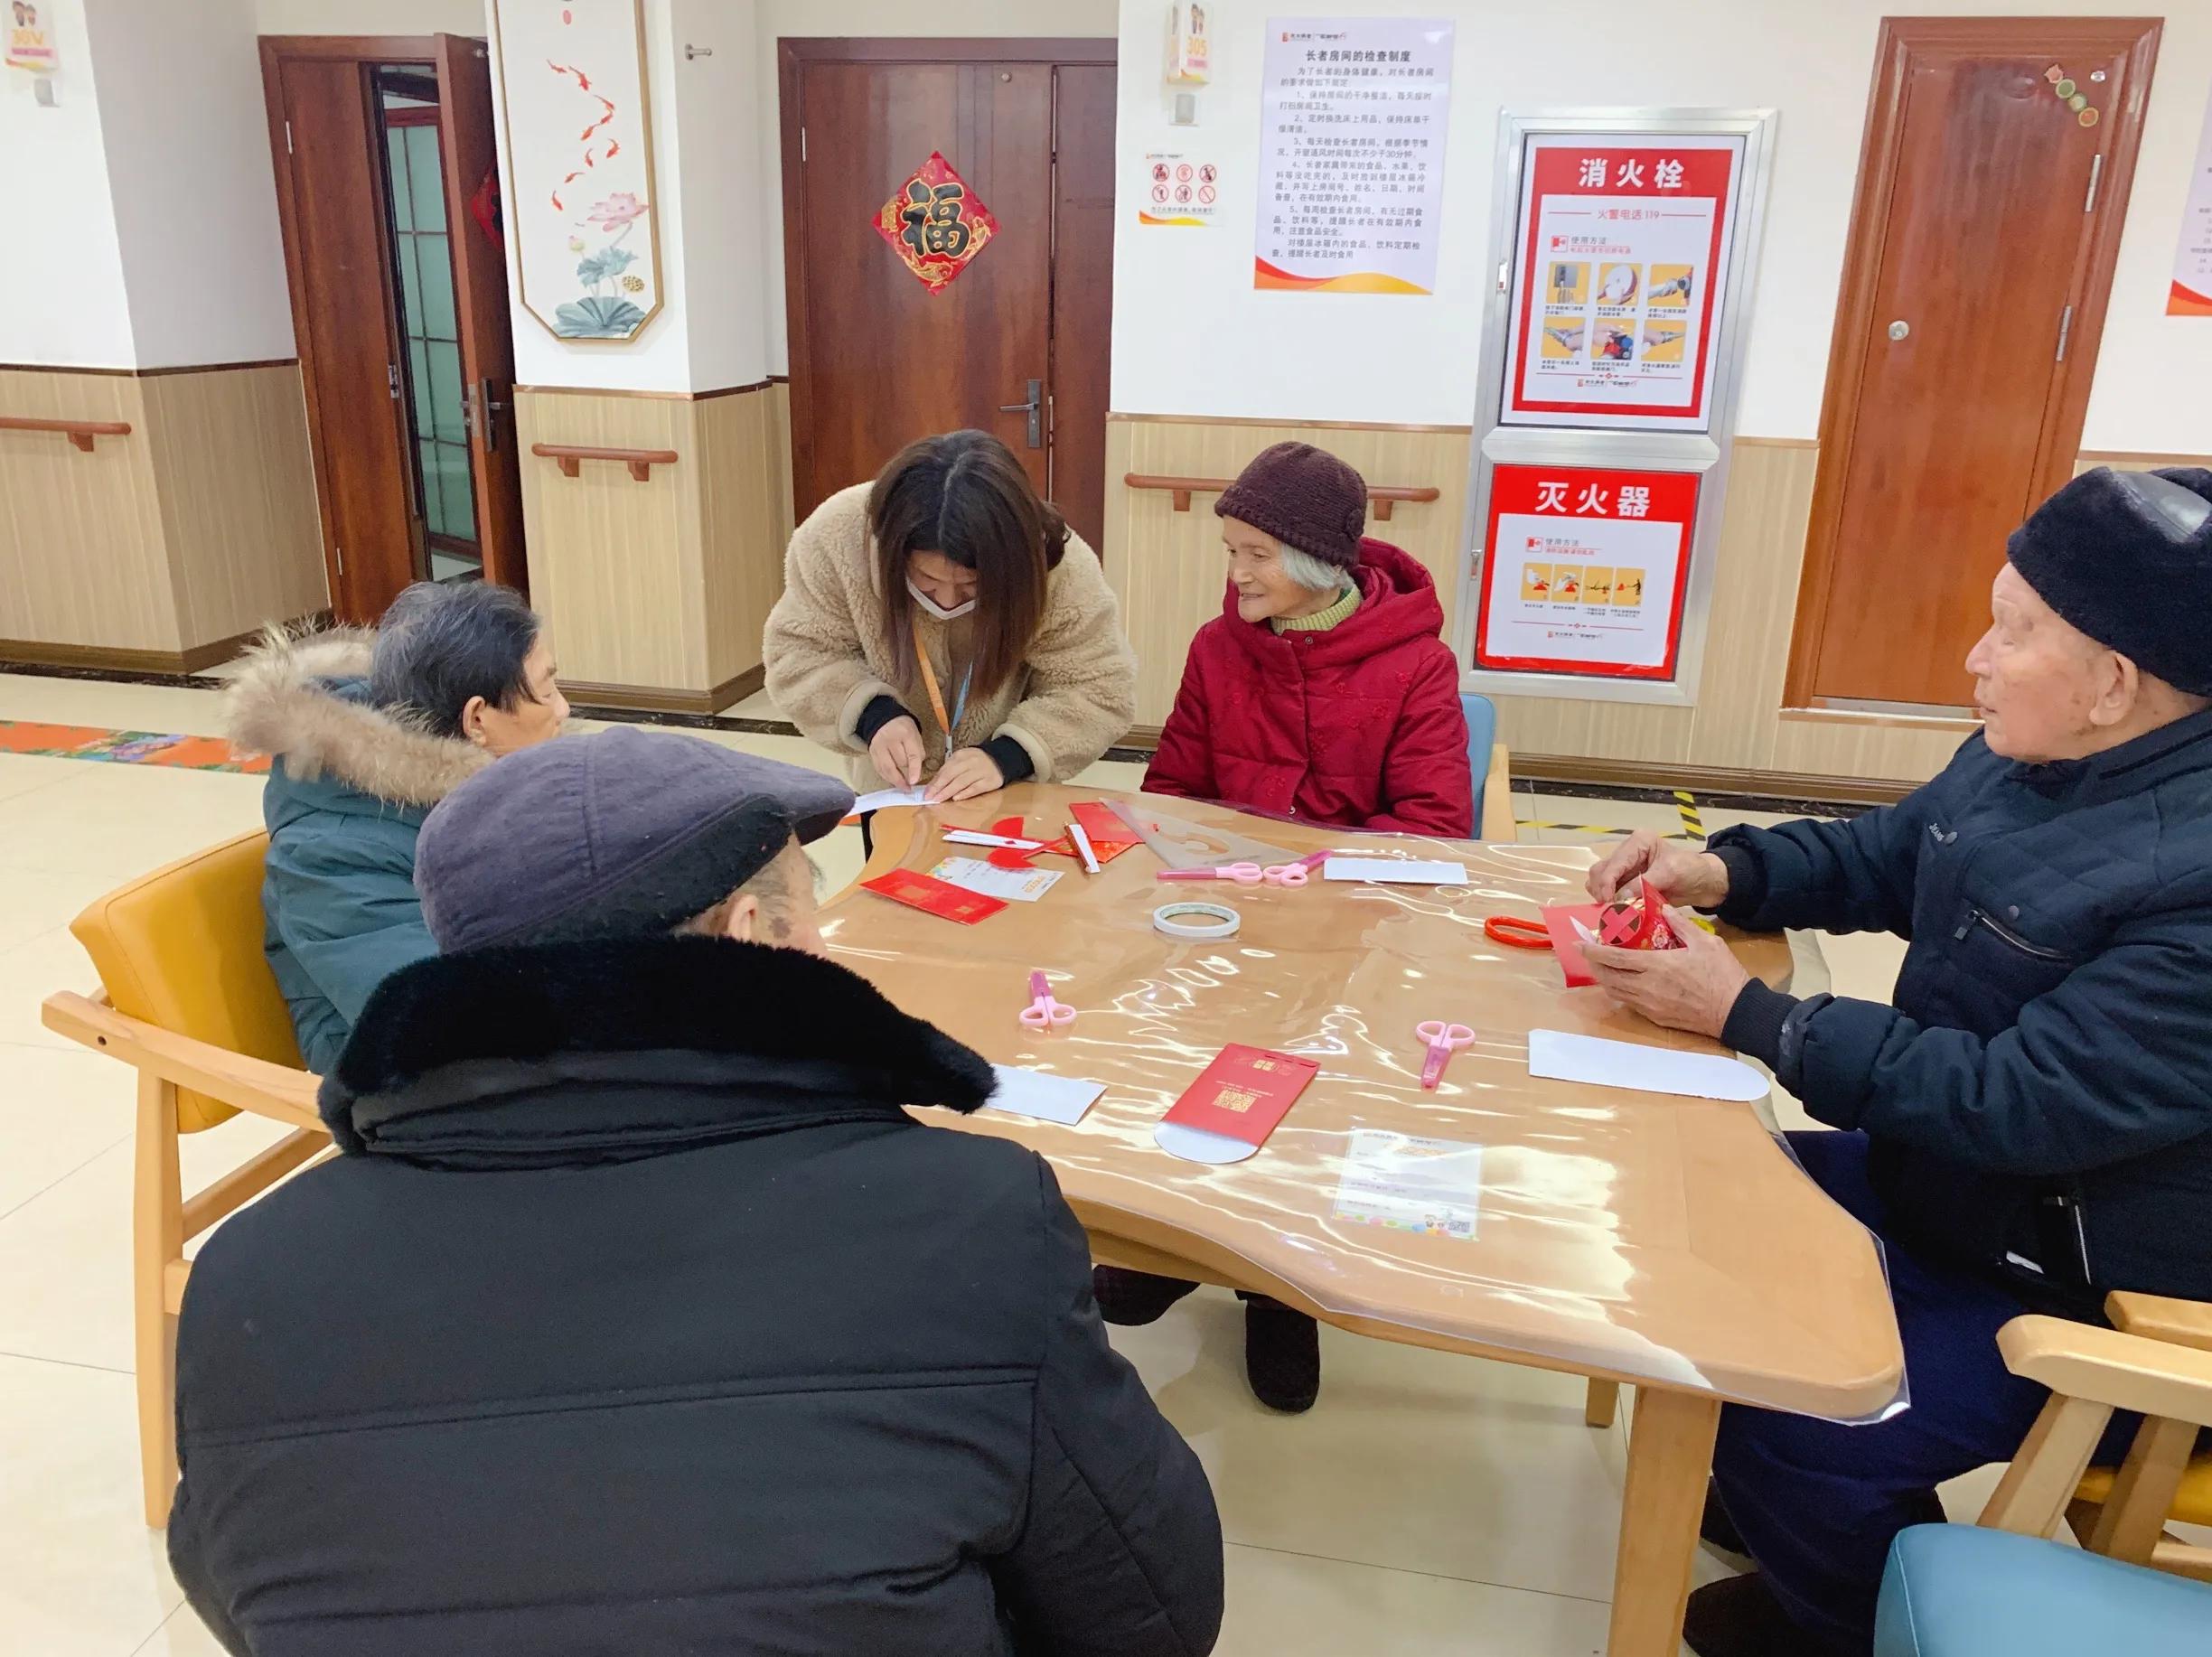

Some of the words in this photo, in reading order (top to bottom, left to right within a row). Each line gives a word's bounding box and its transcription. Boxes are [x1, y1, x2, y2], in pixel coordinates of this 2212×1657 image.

[1306, 50, 1411, 62] 长者房间的检查制度
[1579, 158, 1684, 189] 消火栓
[900, 178, 971, 259] 福
[1570, 236, 1607, 246] 使用方法
[1535, 481, 1650, 518] 灭火器
